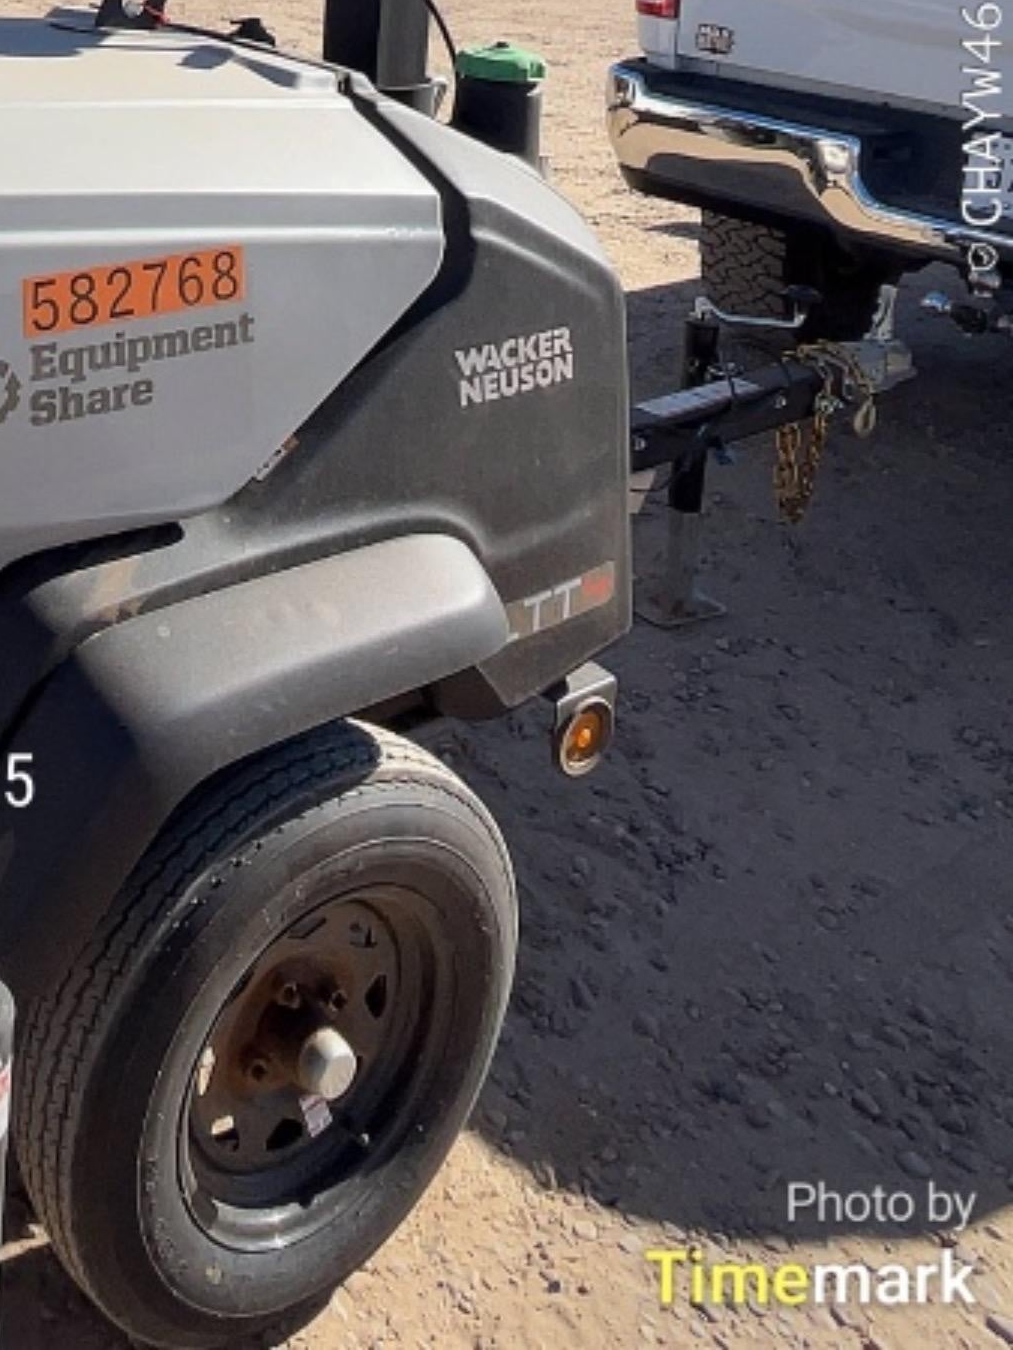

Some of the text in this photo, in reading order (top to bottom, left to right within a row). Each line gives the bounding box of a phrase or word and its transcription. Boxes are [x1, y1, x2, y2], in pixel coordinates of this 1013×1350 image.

[31, 251, 237, 331] 582768
[29, 312, 255, 384] Equipment
[455, 326, 573, 376] WACKER
[30, 378, 154, 427] Share
[459, 353, 574, 407] NEUSON
